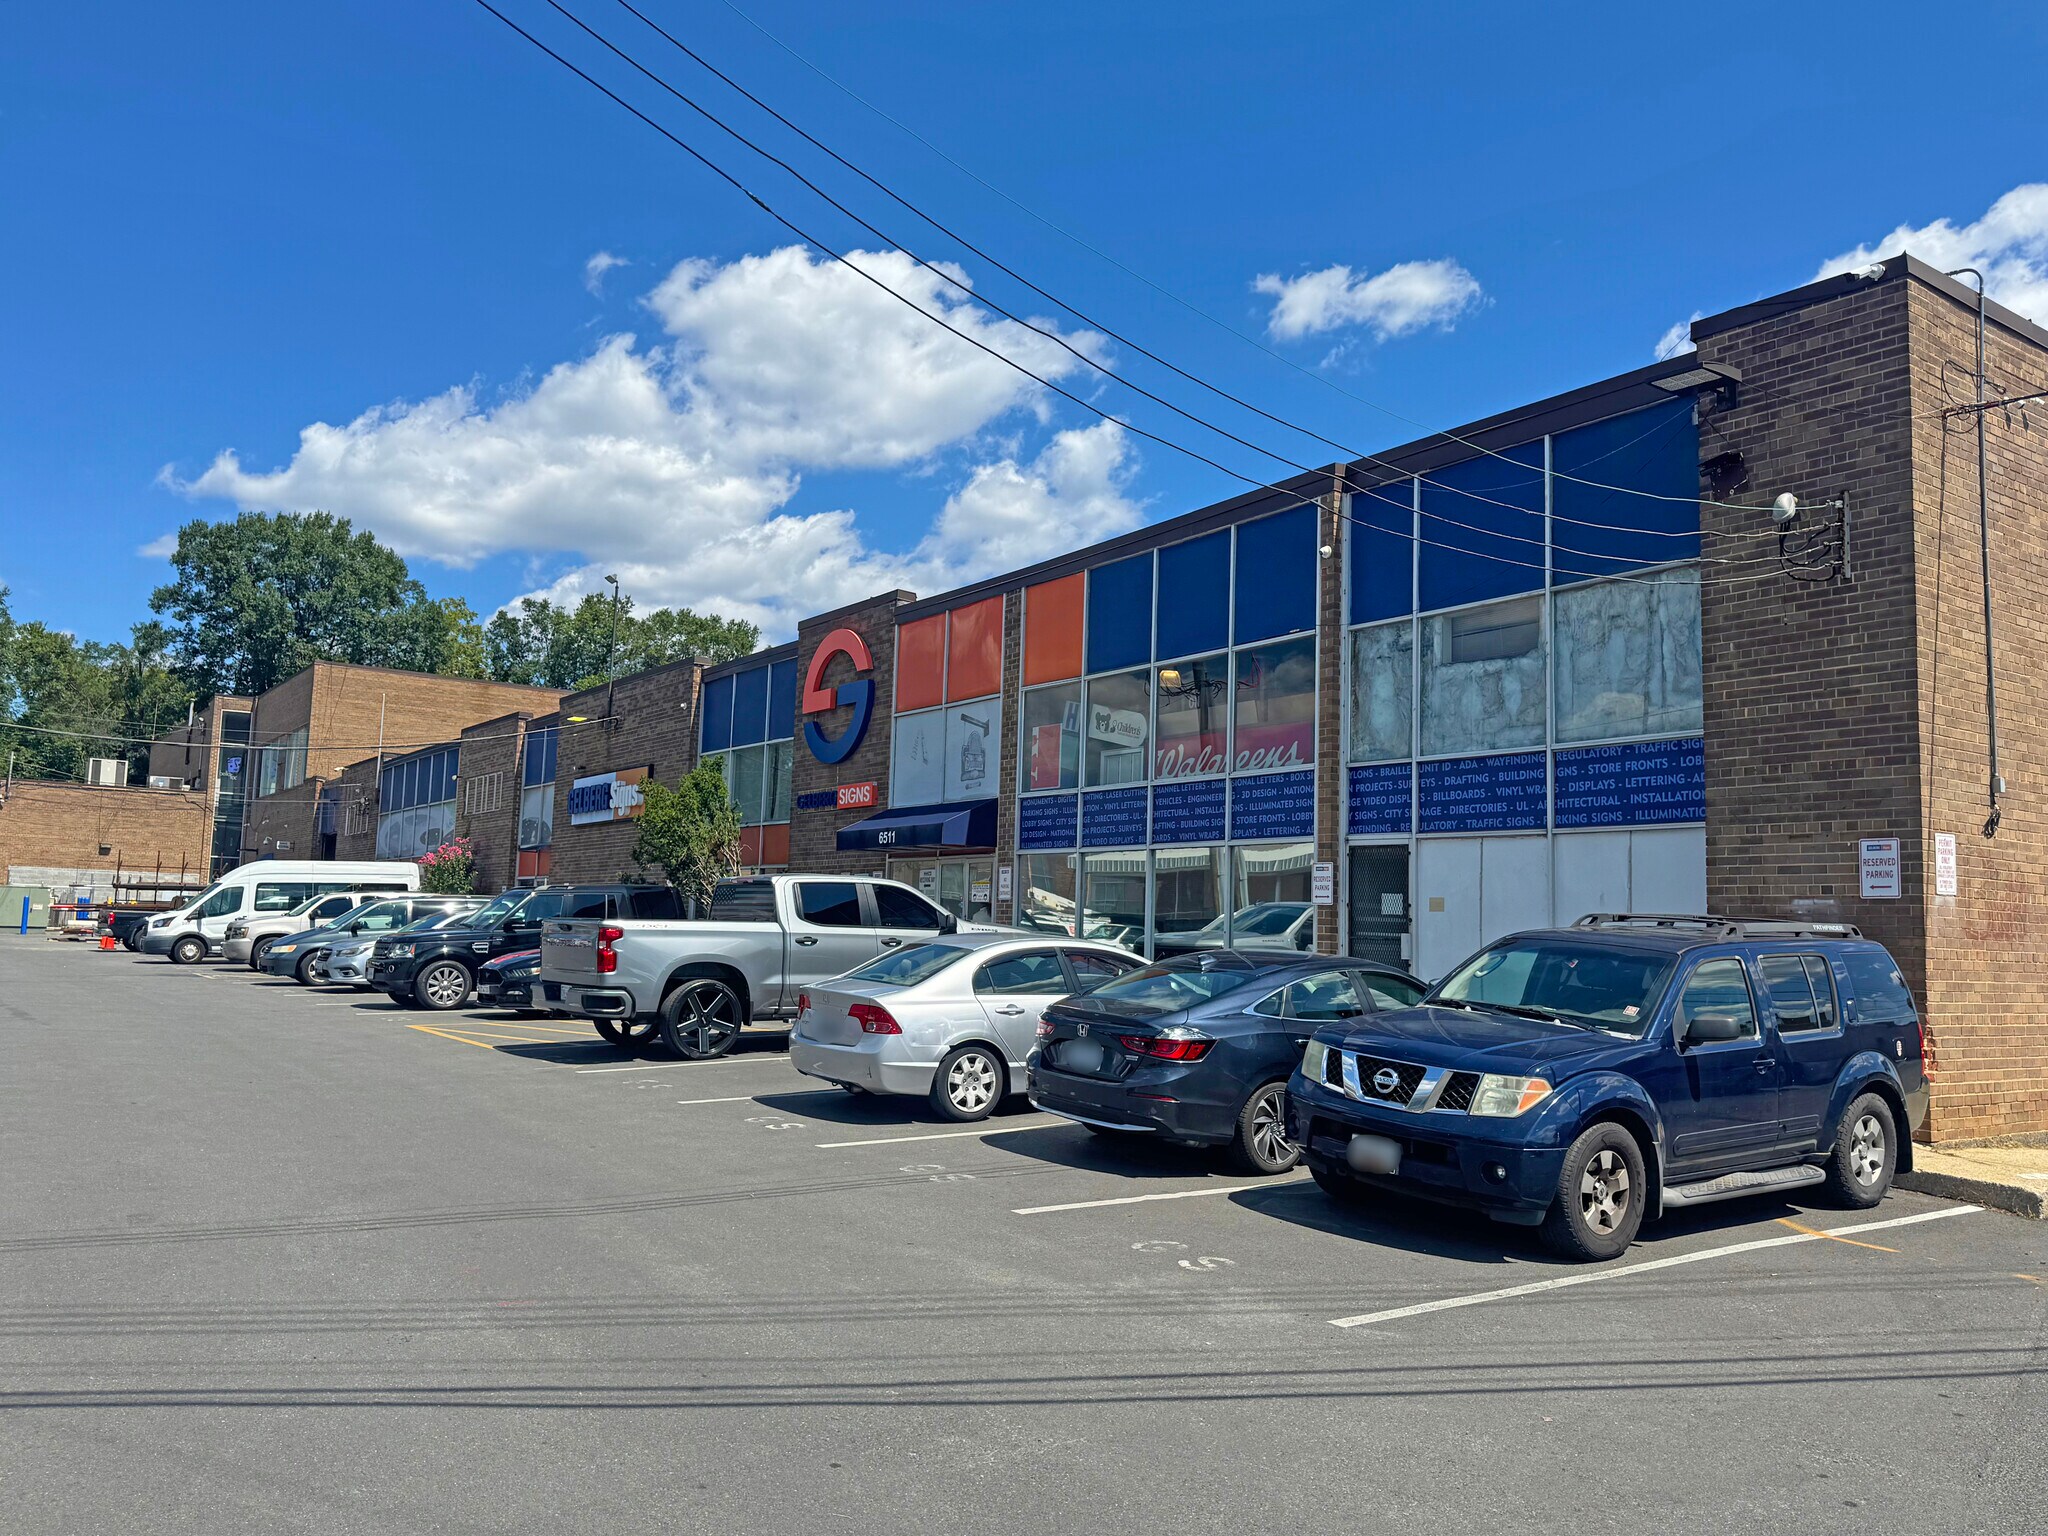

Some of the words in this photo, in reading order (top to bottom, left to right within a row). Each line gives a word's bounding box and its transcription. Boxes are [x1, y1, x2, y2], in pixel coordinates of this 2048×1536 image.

[1380, 765, 1412, 777] BRAILLE
[1442, 761, 1452, 772] ID
[1459, 759, 1478, 770] ADA
[1486, 753, 1546, 768] WAYFINDING
[1556, 746, 1623, 762] REGULATORY
[1633, 741, 1678, 755] TRAFFIC
[1106, 790, 1122, 799] LASER
[1182, 782, 1206, 792] LETTERS
[1256, 774, 1284, 785] LETTERS
[1291, 772, 1305, 782] BOX
[1355, 781, 1393, 793] PROJECTS
[1444, 773, 1489, 786] DRAFTING
[1498, 769, 1544, 782] BUILDING
[1588, 761, 1622, 775] STORE
[1625, 757, 1668, 772] FRONTS
[568, 783, 611, 815] GELBERG
[610, 780, 641, 816] Signs
[840, 785, 870, 805] SIGNS
[1044, 807, 1059, 816] SIGNS
[1104, 801, 1120, 811] VINYL
[1155, 796, 1182, 806] VEHICLES
[1242, 790, 1251, 799] 3D
[1252, 788, 1277, 798] DESIGN
[1363, 795, 1387, 806] VIDEO
[1433, 788, 1486, 801] BILLBOARDS
[1496, 786, 1524, 797] VINYL
[1568, 778, 1616, 793] DISPLAYS
[1625, 773, 1685, 788] LETTERING
[1037, 818, 1052, 827] SIGNS
[1055, 817, 1067, 826] CITY
[1094, 813, 1129, 823] DIRECTORIES
[1133, 812, 1141, 820] UL
[1249, 800, 1294, 811] ILLUMINATED
[1355, 810, 1378, 820] SIGNS
[1384, 808, 1403, 819] CITY
[1449, 802, 1508, 815] DIRECTORIES
[1516, 801, 1529, 811] UL
[1466, 818, 1503, 829] TRAFFIC
[1506, 816, 1535, 827] SIGNS
[1591, 811, 1623, 823] SIGNS
[879, 831, 896, 844] 6511
[1029, 830, 1047, 839] DESIGN
[1051, 828, 1076, 837] NATIONAL
[1090, 824, 1116, 835] PROJECTS
[1118, 823, 1143, 833] SURVEYS
[1180, 818, 1210, 828] BUILDING
[1236, 815, 1258, 825] STORE
[1259, 813, 1286, 823] FRONTS
[1053, 839, 1069, 848] SIGNS
[1091, 836, 1108, 846] VIDEO
[1109, 835, 1134, 845] DISPLAYS
[1179, 831, 1197, 841] VINYL
[1199, 830, 1220, 840] WRAPS
[1263, 826, 1300, 836] LETTERING
[1863, 857, 1896, 867] RESERVED
[1866, 870, 1894, 879] PARKING
